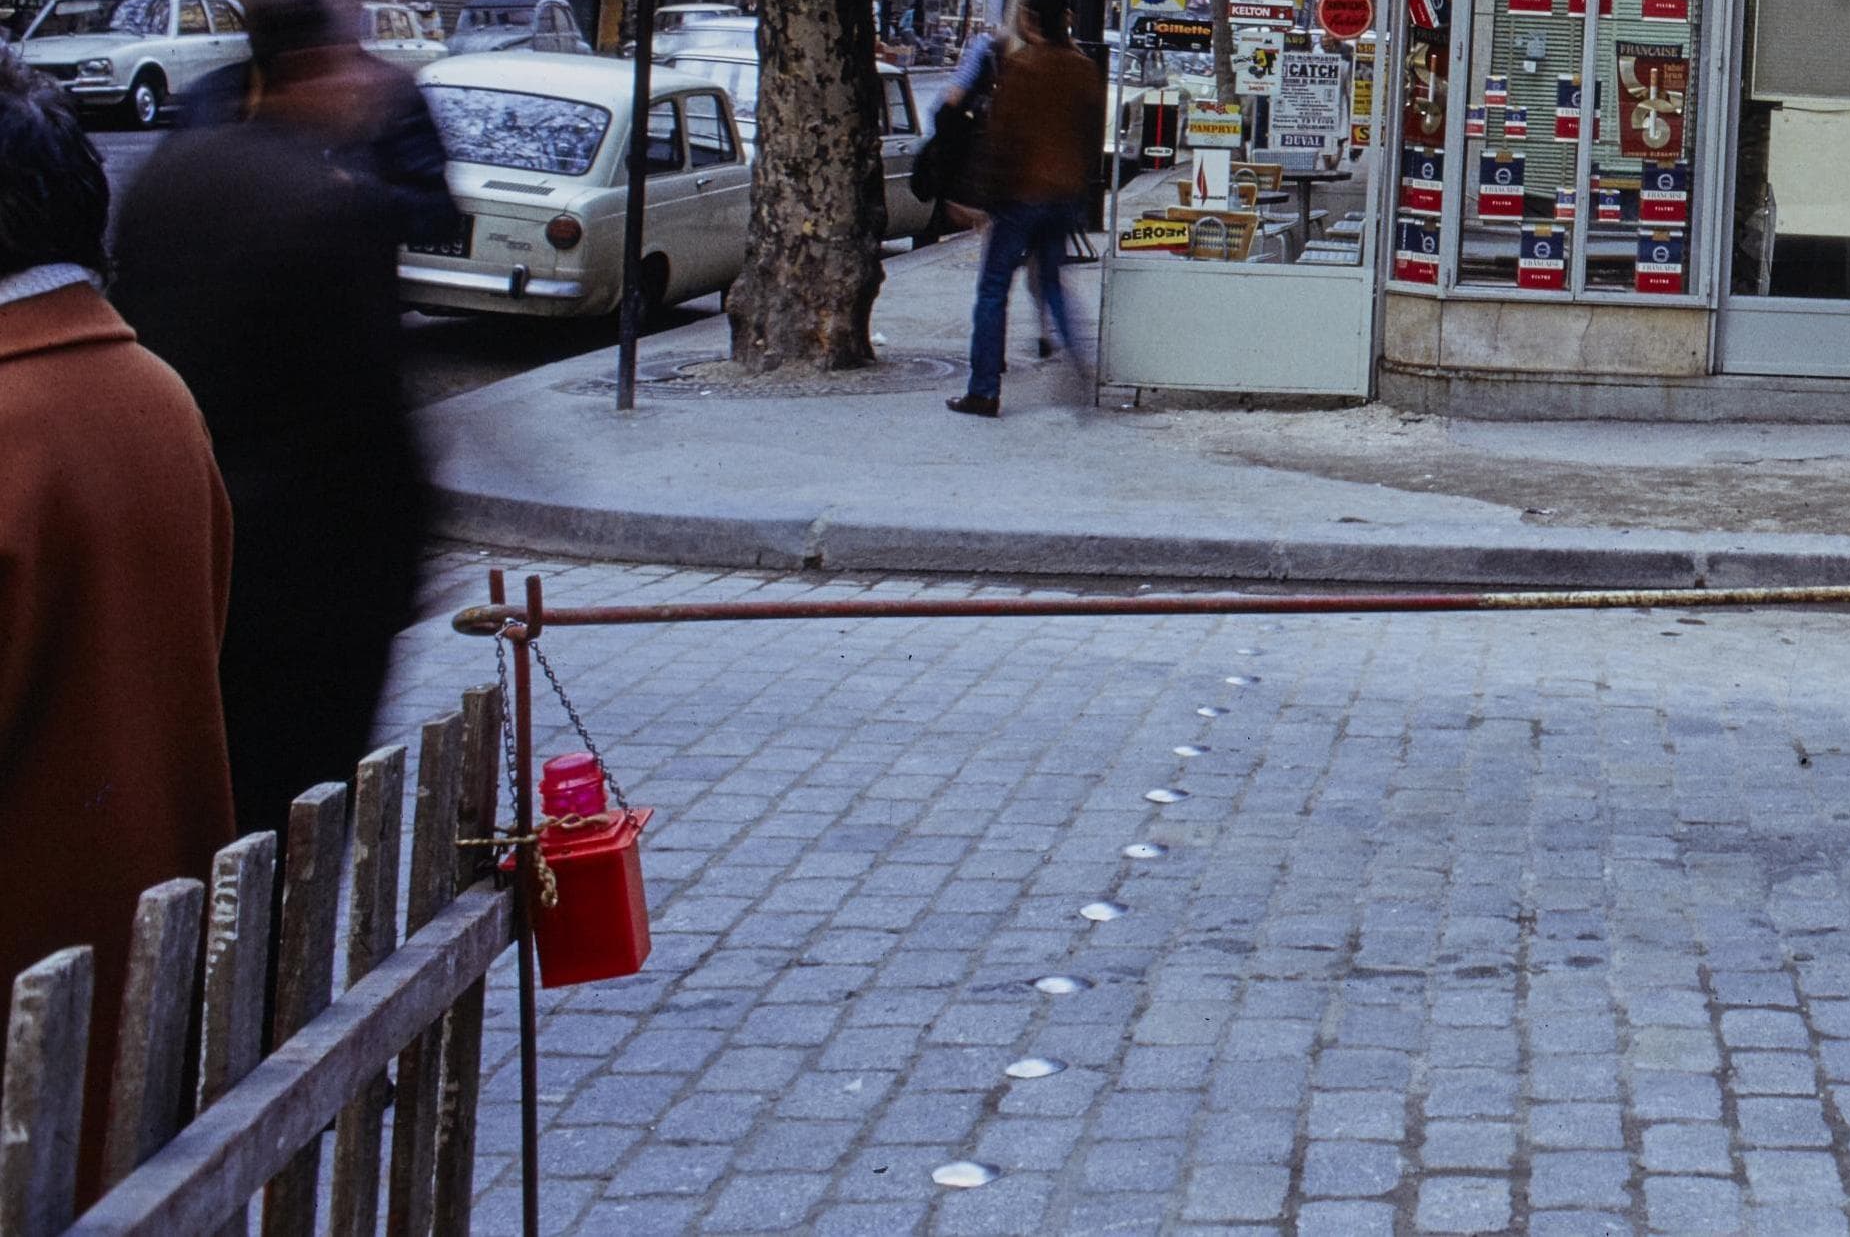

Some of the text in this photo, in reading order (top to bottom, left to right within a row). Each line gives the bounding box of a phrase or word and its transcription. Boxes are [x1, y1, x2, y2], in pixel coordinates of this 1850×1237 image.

[1231, 6, 1271, 17] KELTON
[1158, 23, 1211, 35] Gillette
[1289, 63, 1339, 78] CATCH
[1190, 123, 1240, 134] PAMPRYL
[1285, 135, 1321, 146] DUVAL
